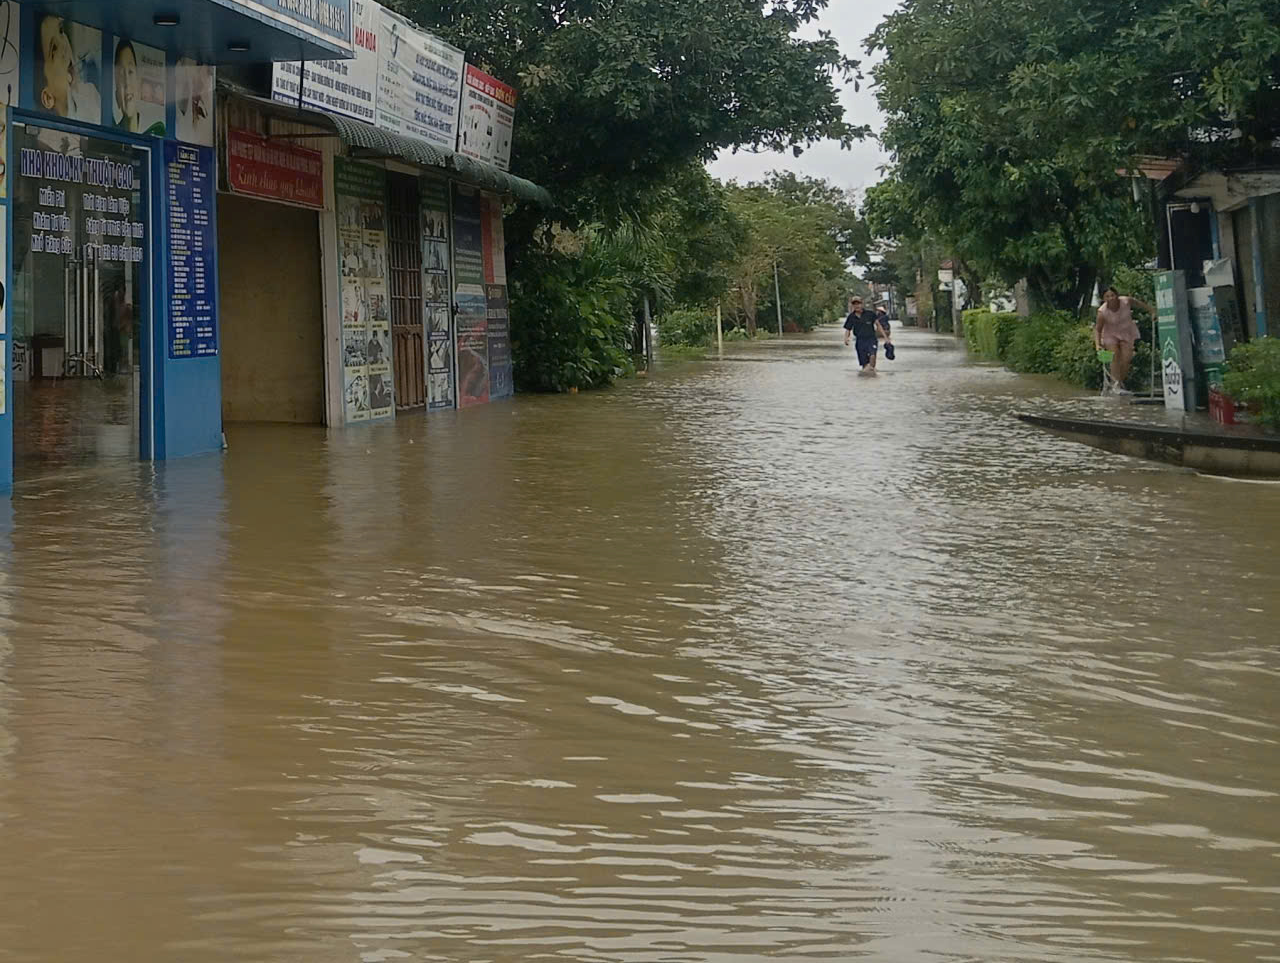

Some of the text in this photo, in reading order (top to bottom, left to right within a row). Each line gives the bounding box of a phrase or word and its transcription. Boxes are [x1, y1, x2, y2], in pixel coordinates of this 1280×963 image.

[21, 147, 42, 178] NHA
[44, 151, 70, 181] KHOA
[86, 156, 115, 192] THUẬT
[116, 163, 135, 190] CAO
